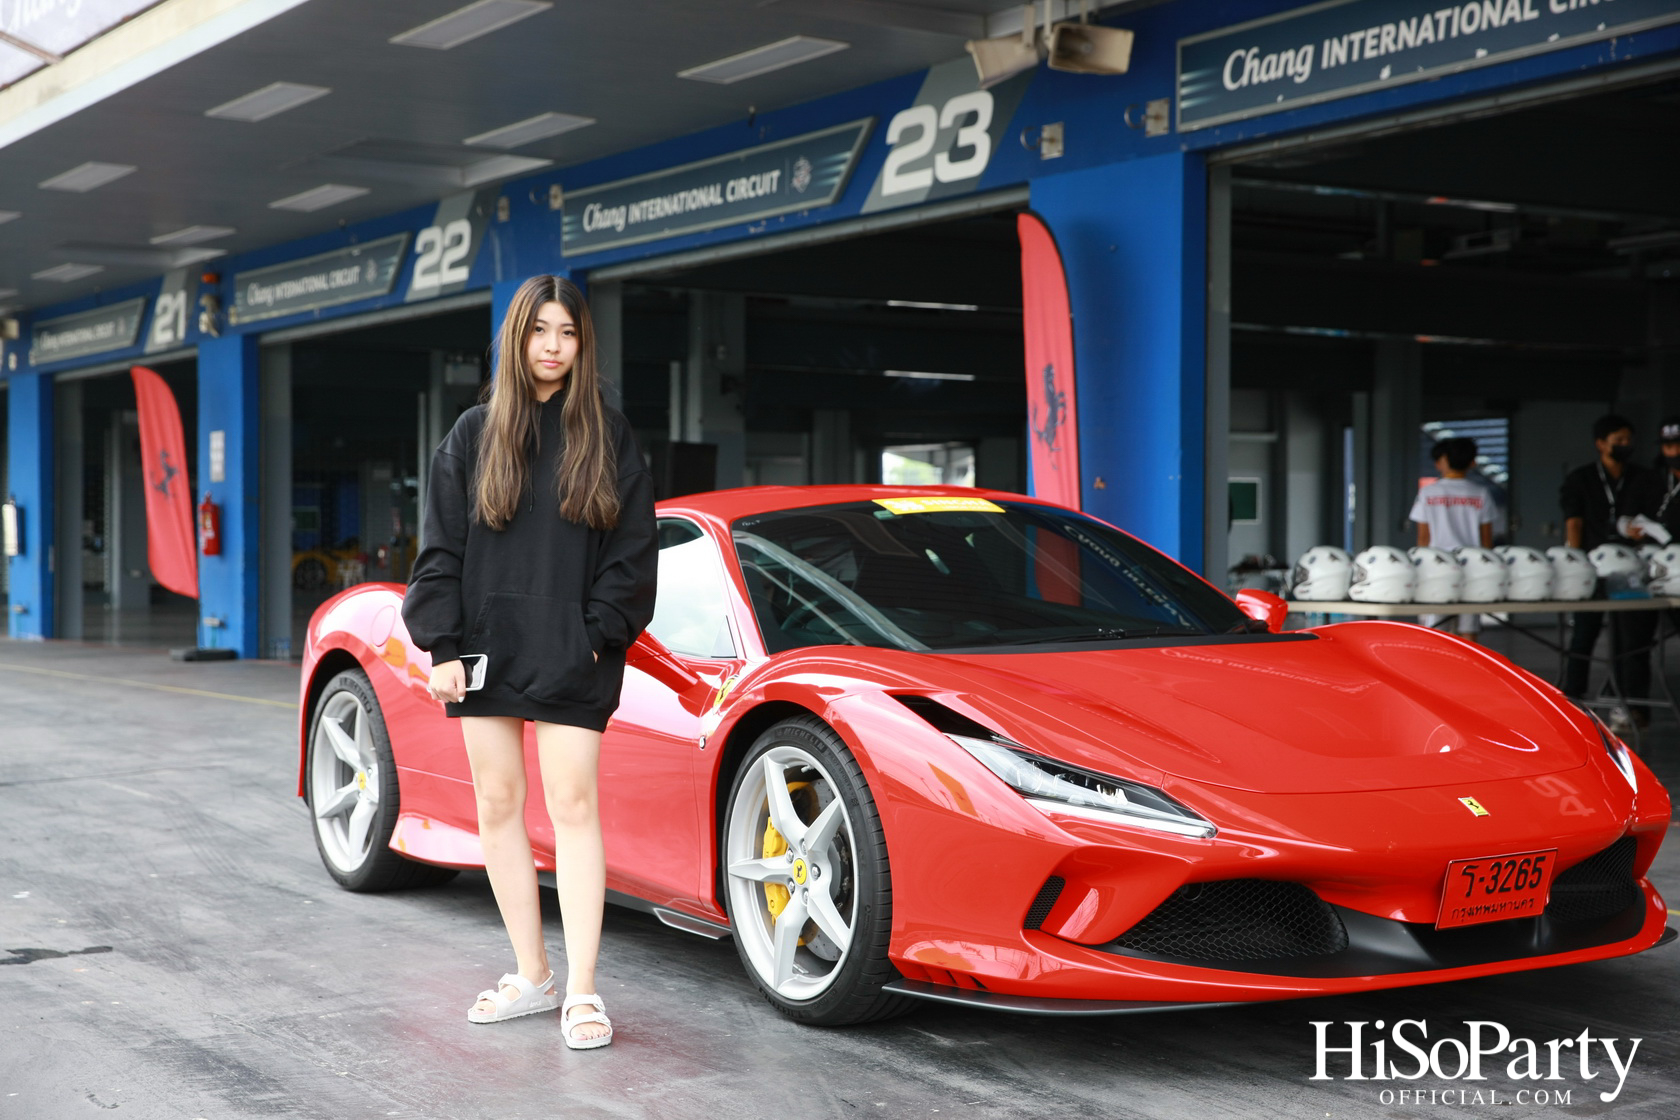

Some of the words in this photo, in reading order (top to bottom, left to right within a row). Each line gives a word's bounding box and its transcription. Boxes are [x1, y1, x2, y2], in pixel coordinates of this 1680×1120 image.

[1222, 45, 1315, 91] Chang
[1321, 0, 1540, 70] INTERNATIONAL
[881, 89, 994, 197] 23
[582, 203, 627, 233] Chang
[628, 183, 724, 224] INTERNATIONAL
[726, 169, 781, 203] CIRCUIT
[413, 218, 472, 291] 22
[154, 289, 187, 345] 21
[783, 727, 827, 752] MICHELIN
[1451, 898, 1535, 923] กรุงเทพมหานคร
